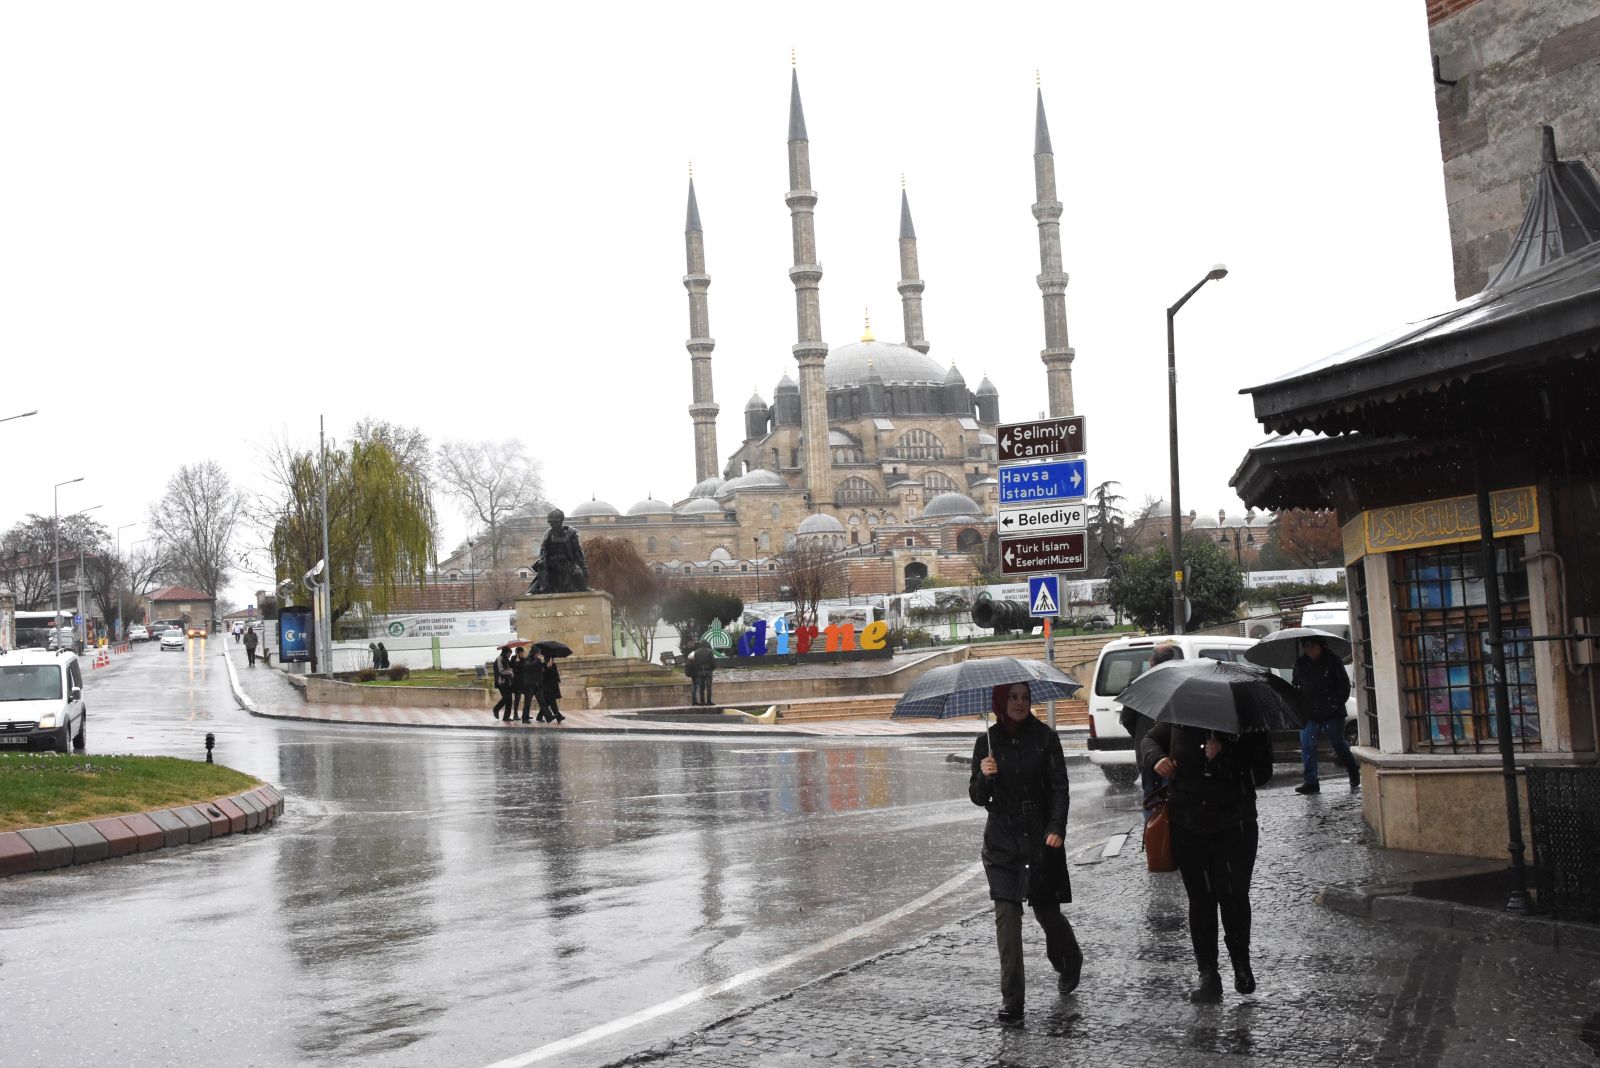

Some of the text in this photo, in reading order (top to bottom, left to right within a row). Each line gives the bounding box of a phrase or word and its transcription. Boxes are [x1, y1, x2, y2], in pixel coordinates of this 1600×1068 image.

[1013, 424, 1077, 441] Selimiye
[1014, 440, 1059, 457] Camii
[1002, 470, 1049, 484] Havsa
[1002, 484, 1058, 500] İstanbul
[1018, 510, 1081, 526] Belediye
[1015, 541, 1070, 554] Türk İslam
[1016, 553, 1082, 568] Eserleri Müzesi
